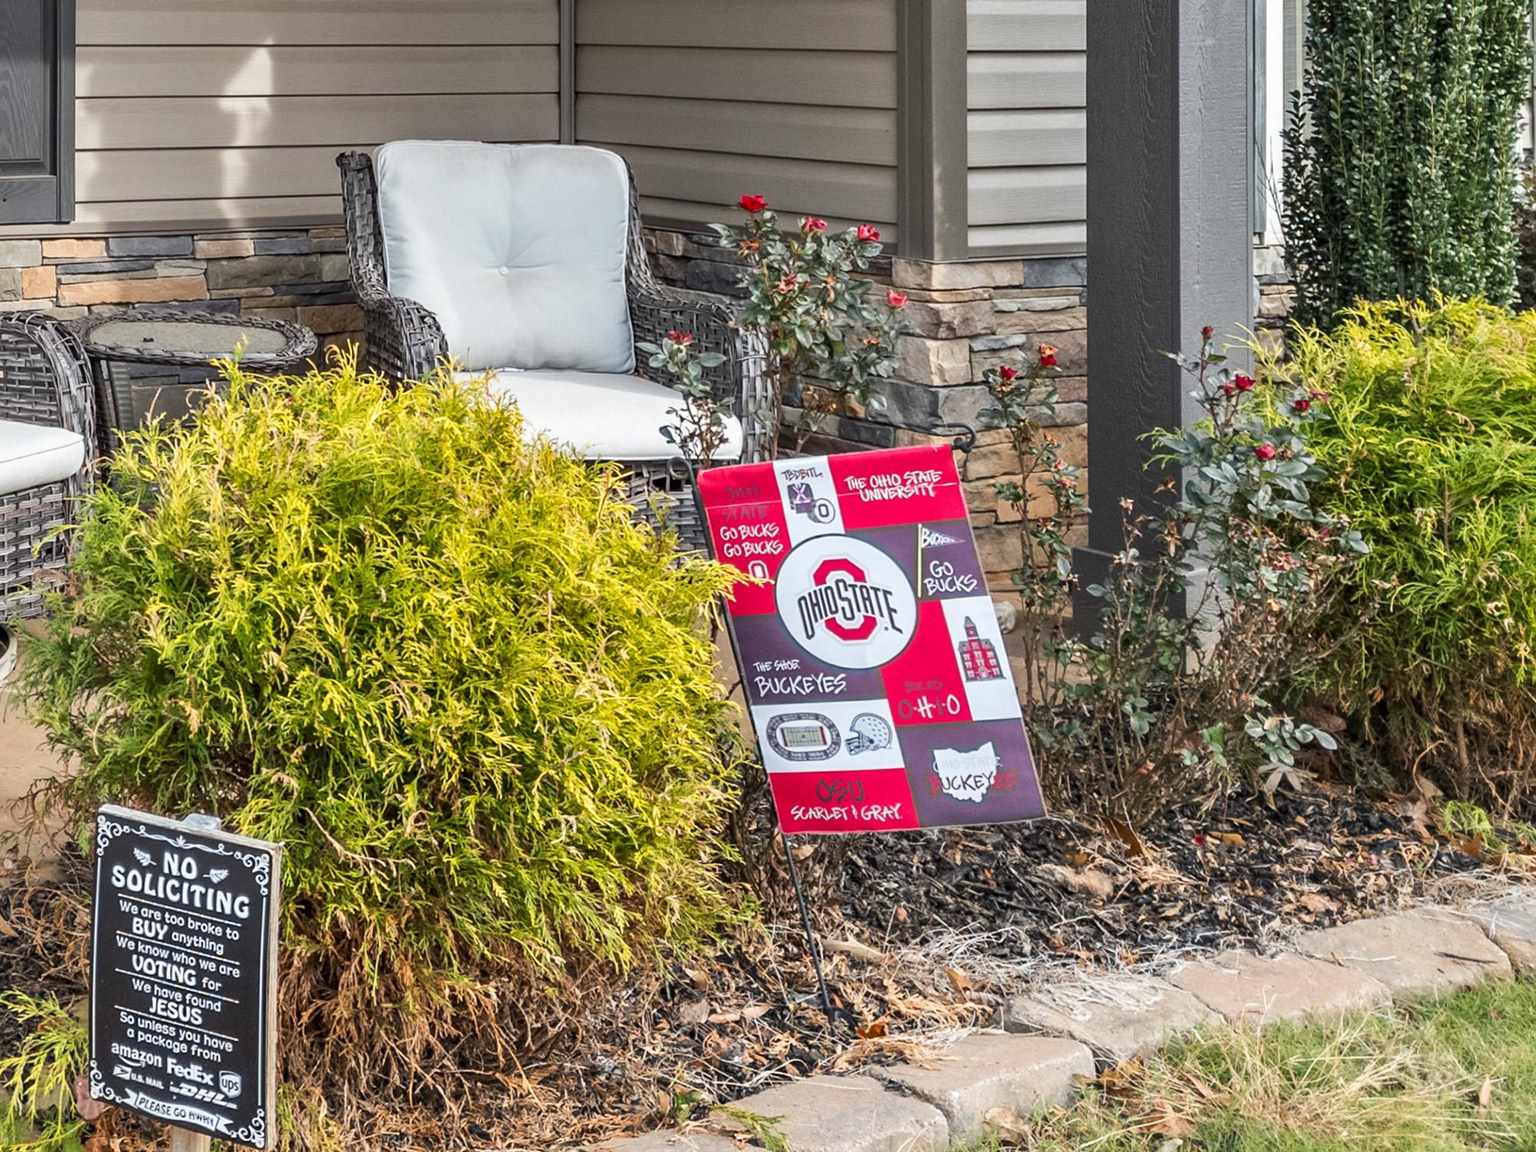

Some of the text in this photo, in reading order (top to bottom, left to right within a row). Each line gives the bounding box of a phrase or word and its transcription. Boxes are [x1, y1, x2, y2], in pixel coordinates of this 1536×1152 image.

[843, 469, 942, 490] THE OHIO STATE
[859, 483, 936, 502] UNIVERSITY
[720, 522, 780, 541] GO BUCKS
[724, 540, 784, 558] GO BUCKS
[929, 560, 954, 578] GO
[924, 574, 978, 596] BUCKS
[752, 661, 773, 673] THE
[754, 673, 846, 697] BUCKEYES
[790, 805, 848, 821] SCARLET
[861, 803, 903, 822] GRAY
[163, 851, 198, 880] NO
[111, 865, 251, 919] SOLICITING
[119, 899, 240, 940] We are too broke to
[132, 917, 224, 955] BUY anything
[116, 935, 240, 978] We know who we are
[132, 954, 222, 992] VOTING for
[132, 978, 222, 1012] We have found
[149, 997, 203, 1025] JESUS
[119, 1012, 233, 1052] So unless you have
[127, 1028, 221, 1063] a package from
[111, 1042, 240, 1092] amazon FedEx ups
[178, 1082, 231, 1107] DHL
[138, 1097, 171, 1117] PLEASE
[173, 1108, 186, 1119] GO
